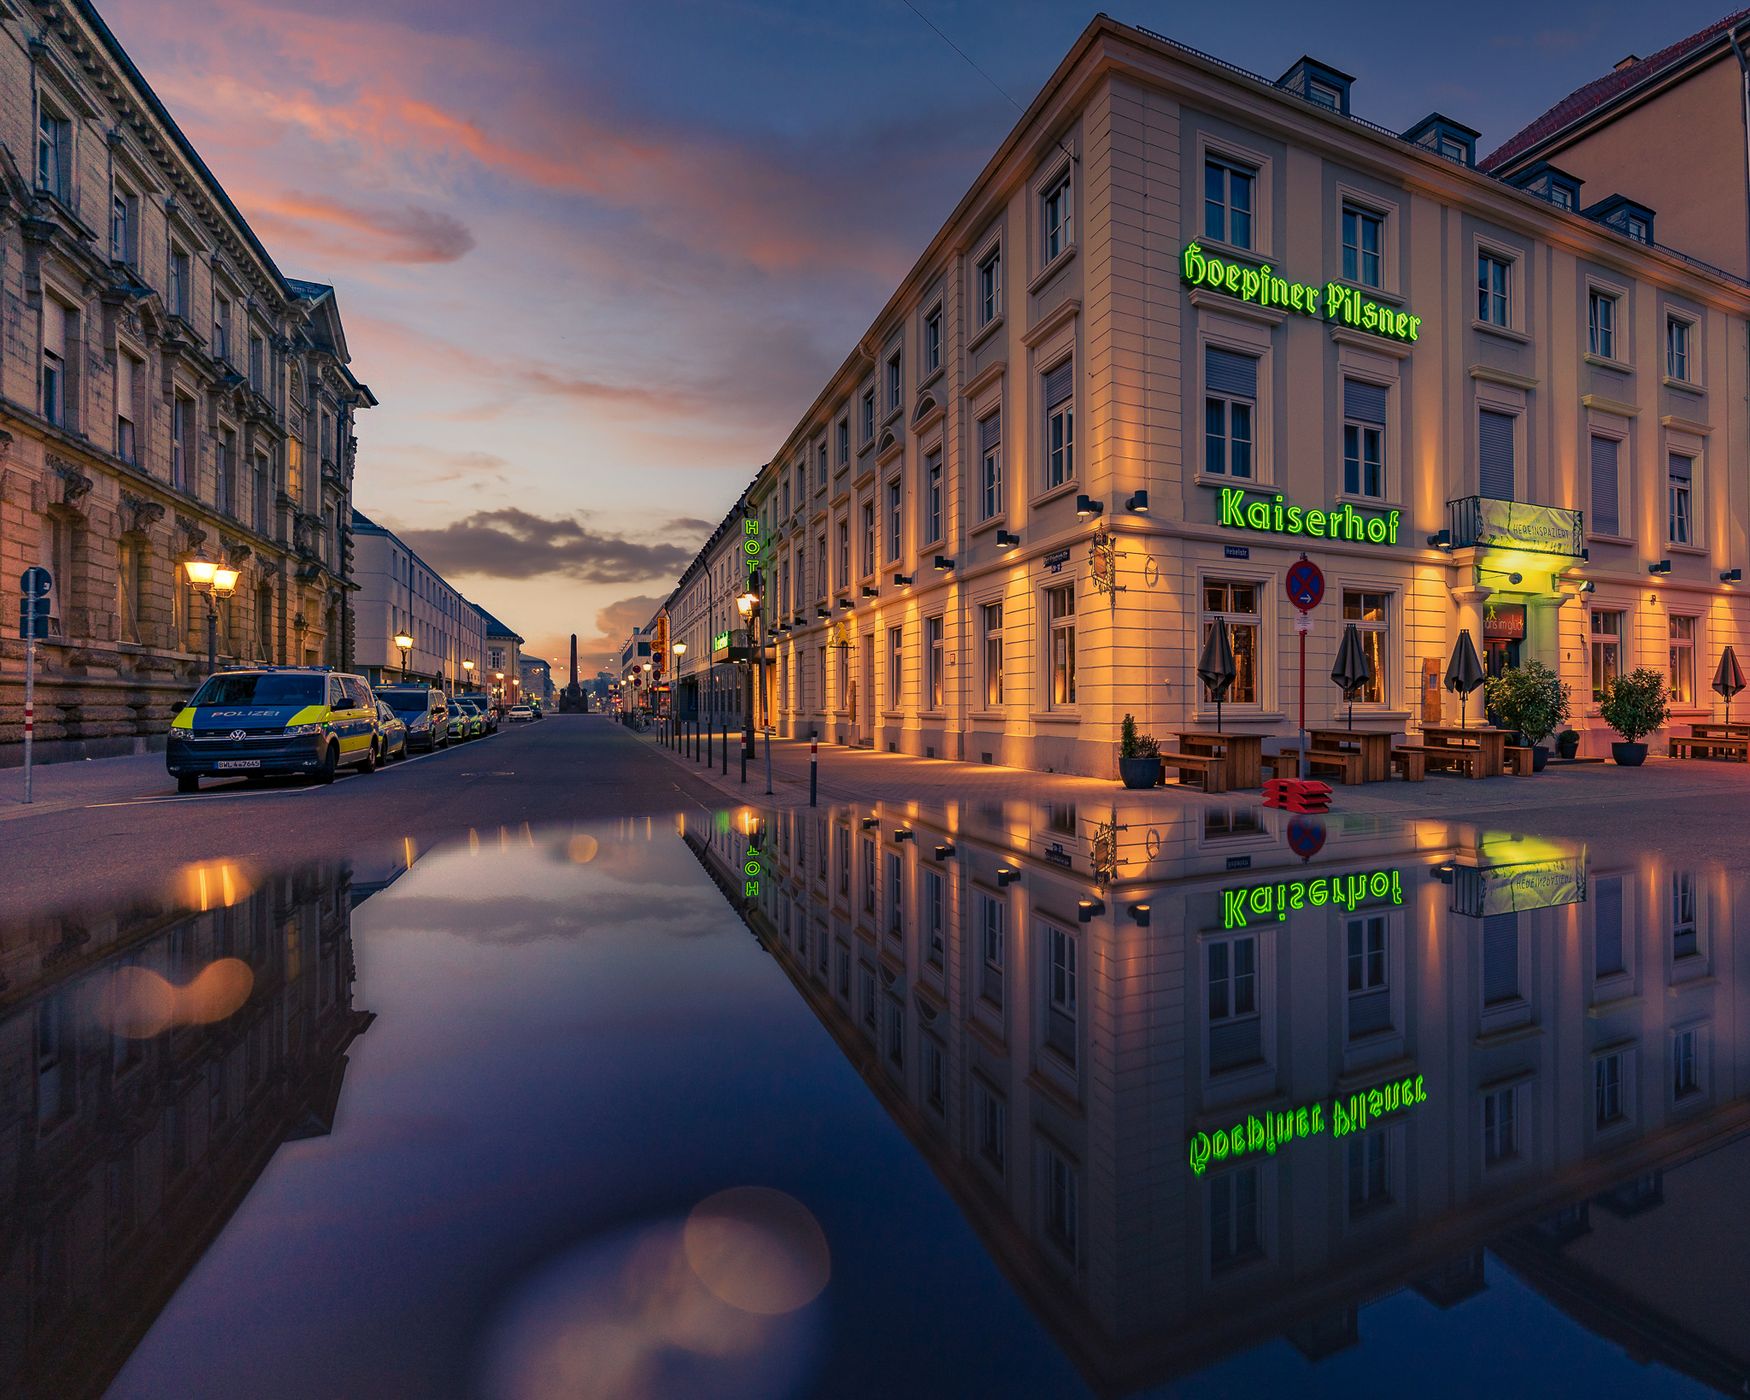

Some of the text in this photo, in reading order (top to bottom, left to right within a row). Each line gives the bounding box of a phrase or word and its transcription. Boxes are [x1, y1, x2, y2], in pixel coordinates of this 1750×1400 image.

[1183, 241, 1422, 341] Hoepfner Pilsner
[1221, 488, 1399, 544] Kaiserhof
[744, 519, 760, 592] HOT
